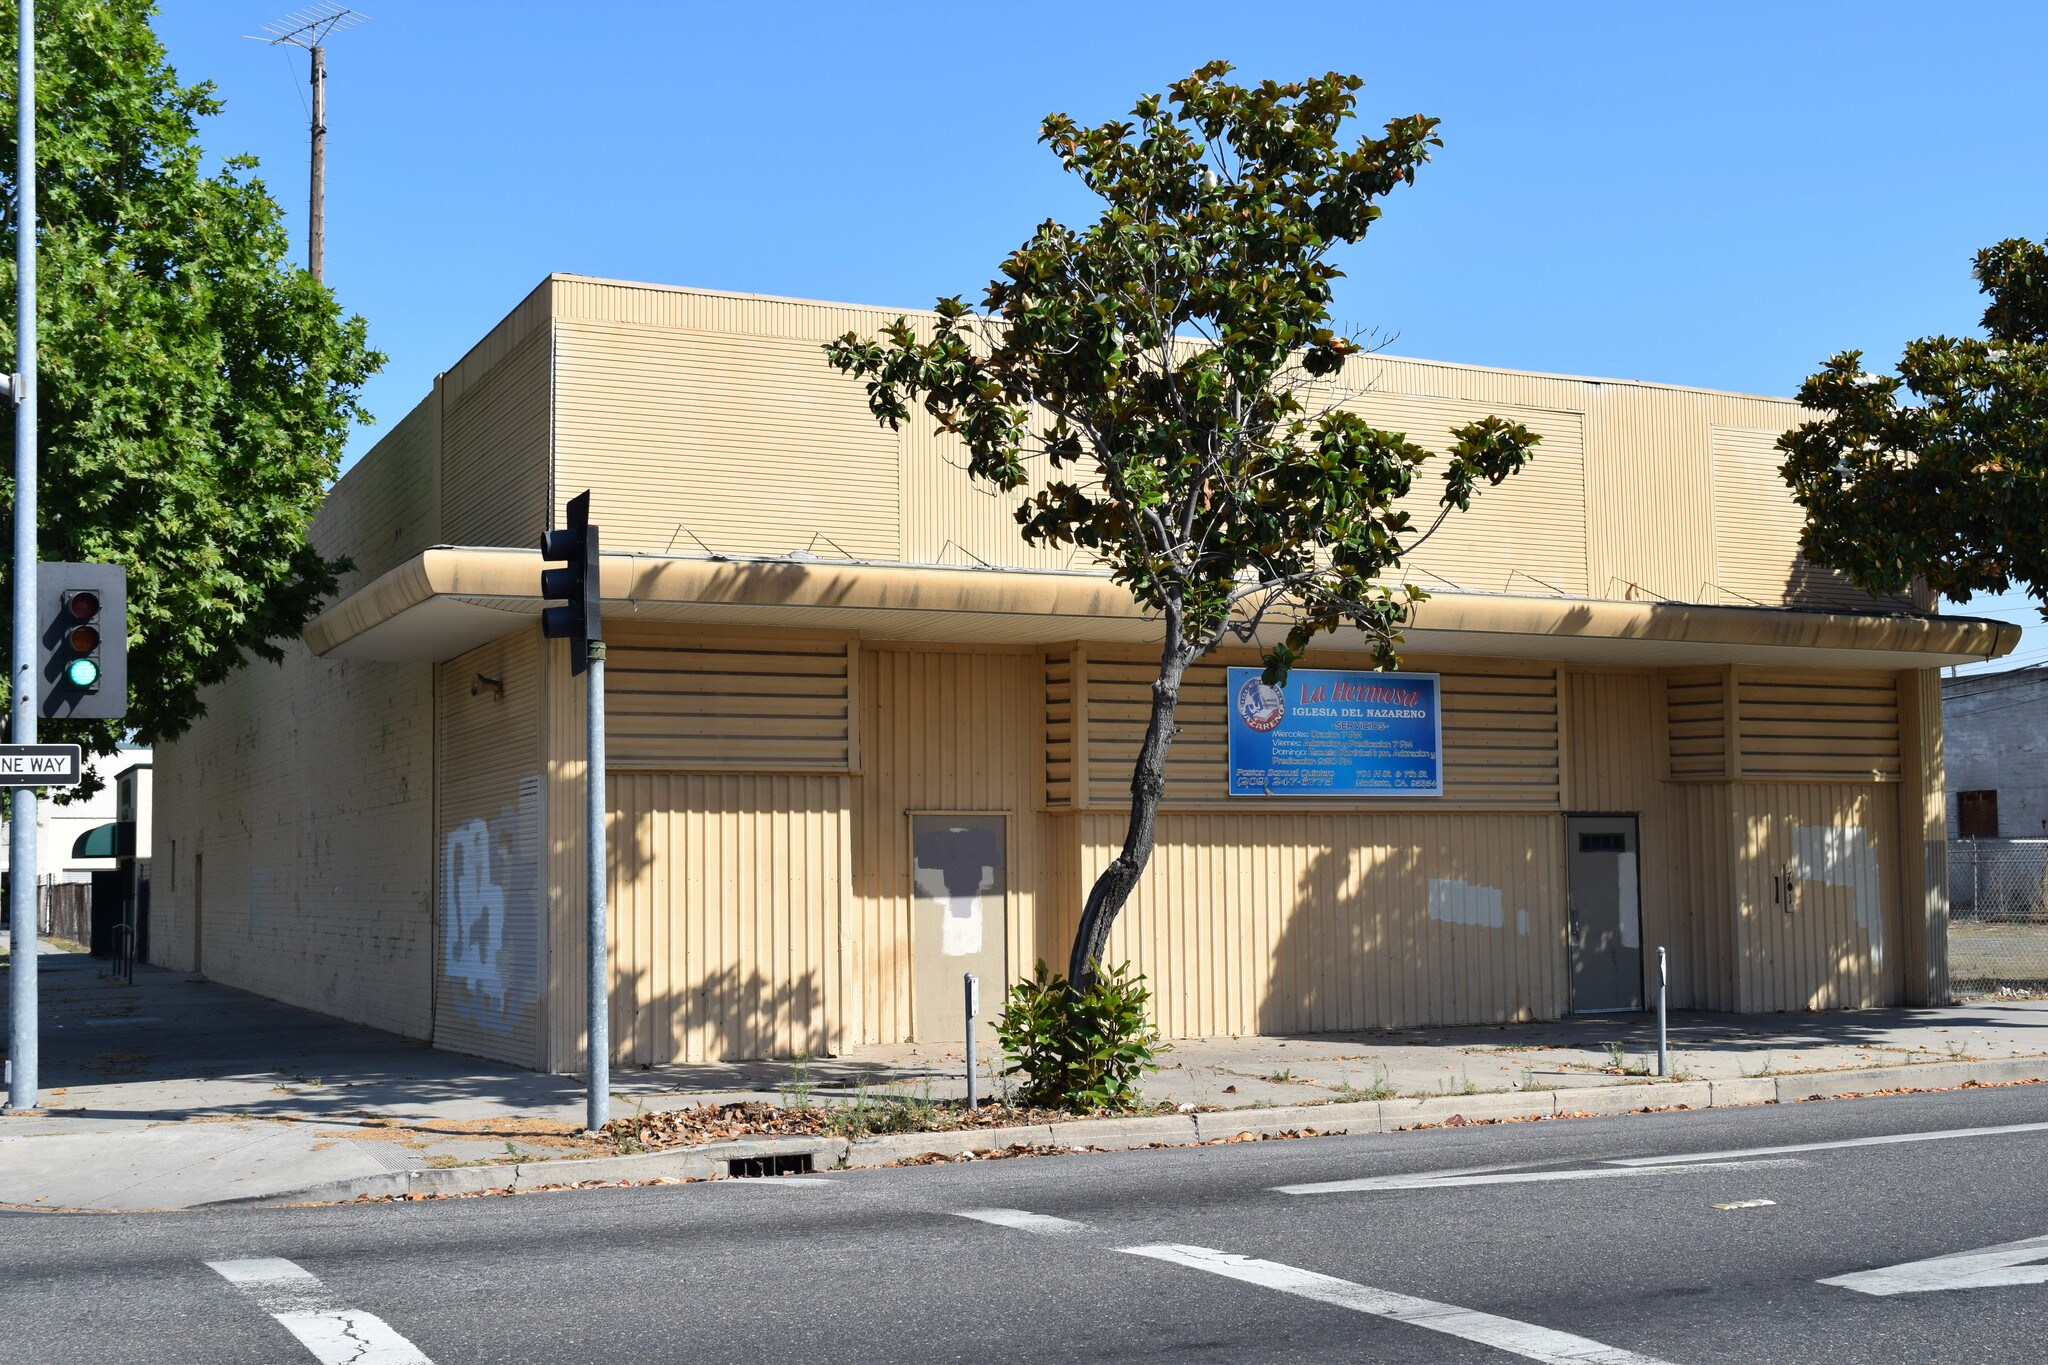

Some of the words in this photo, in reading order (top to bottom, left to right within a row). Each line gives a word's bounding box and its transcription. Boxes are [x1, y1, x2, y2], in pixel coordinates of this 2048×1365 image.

[1300, 683, 1326, 705] La
[1331, 680, 1421, 707] Hermosa
[1241, 706, 1286, 731] NAZARENO
[1292, 707, 1338, 717] IGLESIA
[1341, 708, 1363, 717] DEL
[1366, 709, 1426, 718] NAZARENO
[0, 757, 24, 773] NE
[30, 757, 66, 773] WAY
